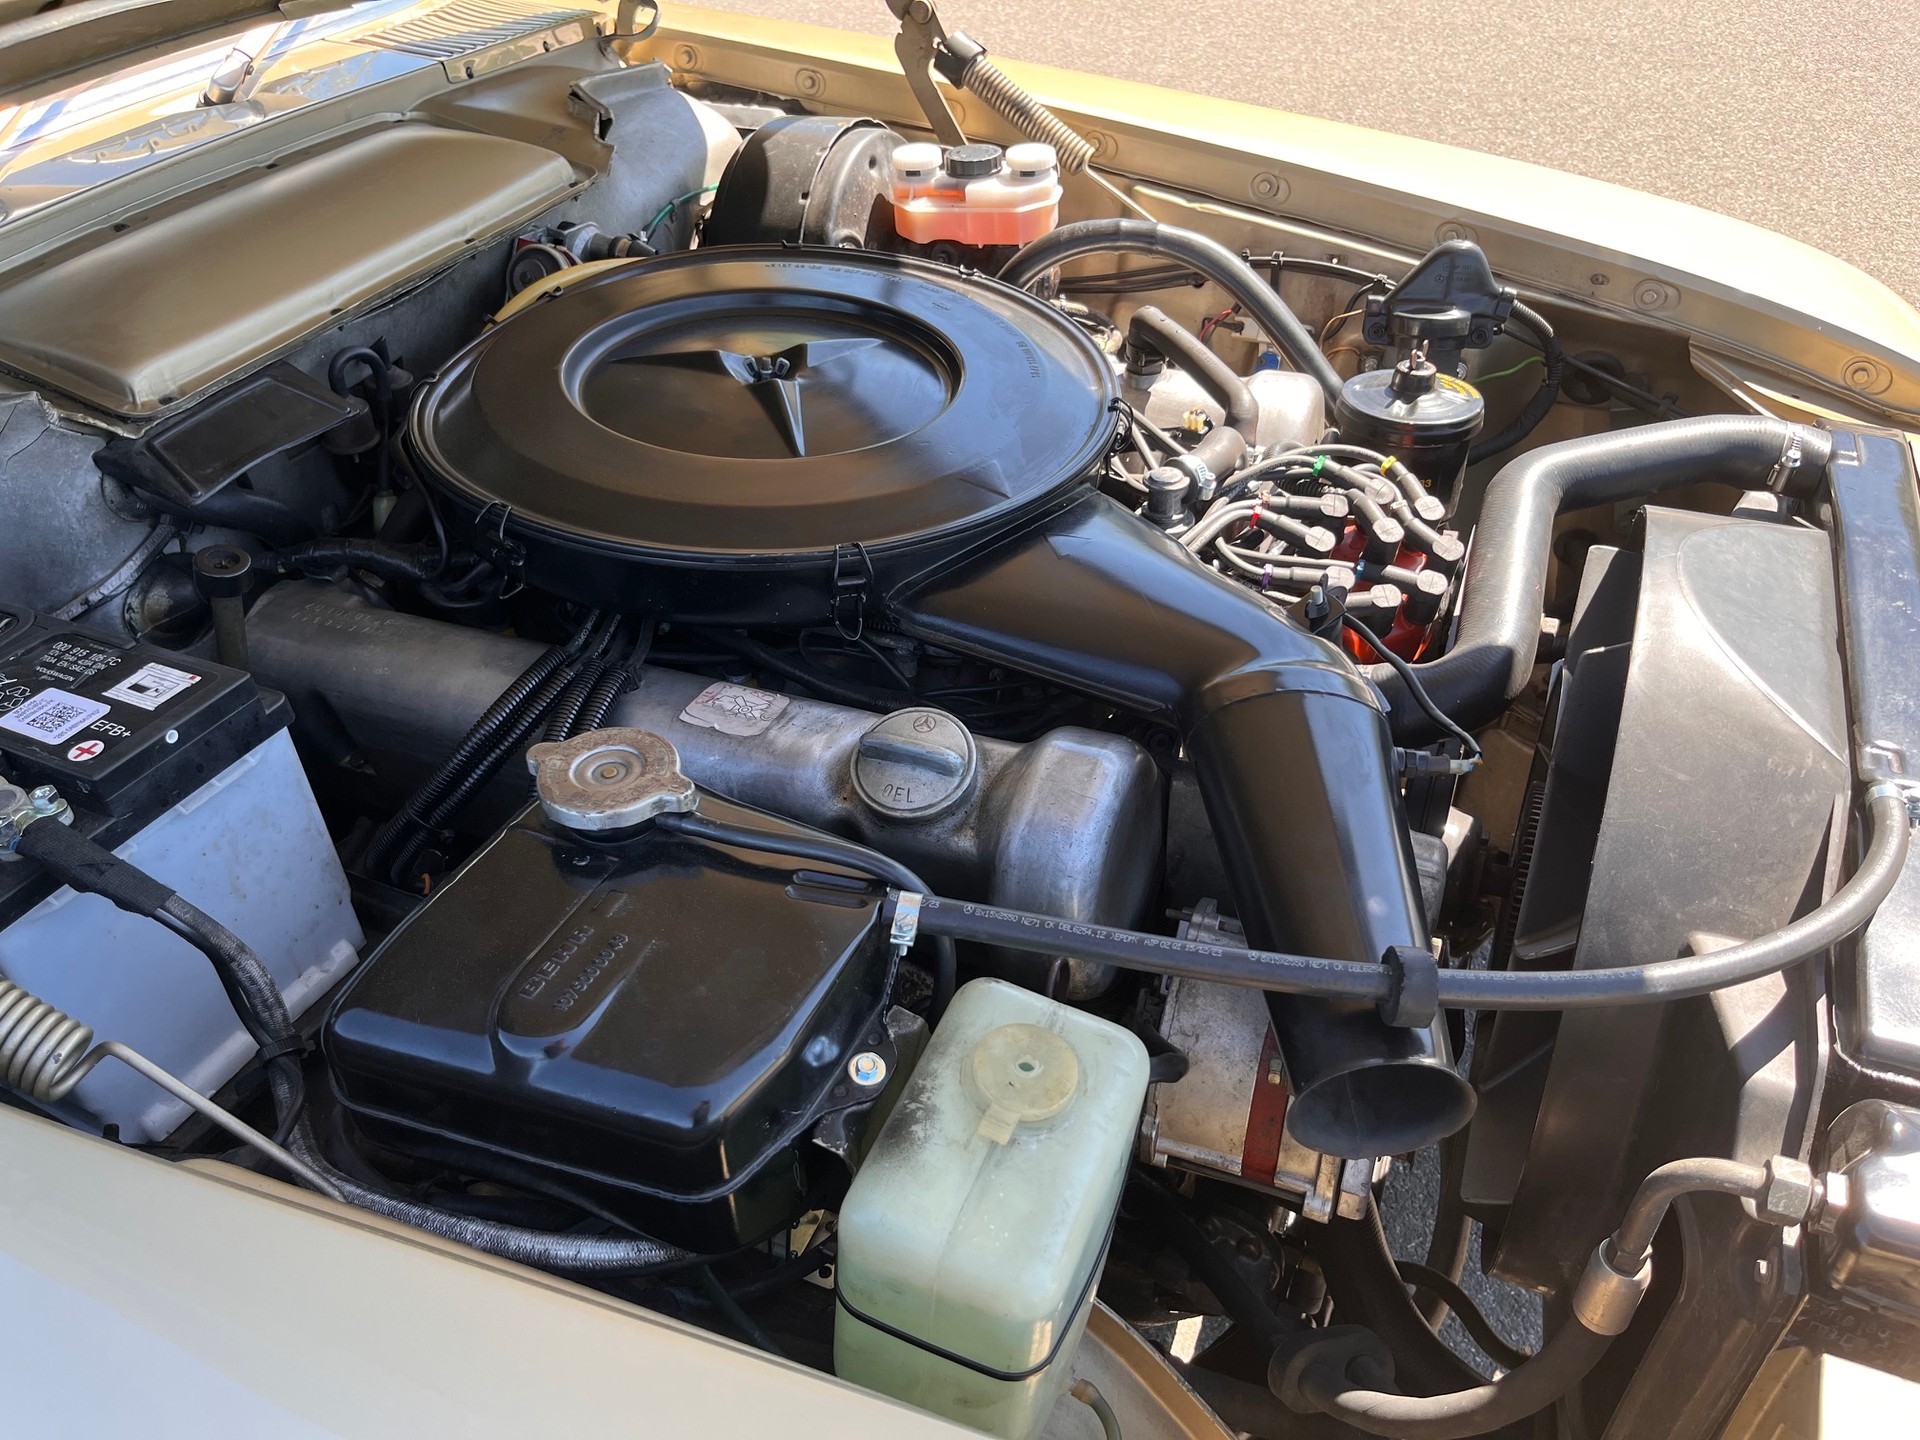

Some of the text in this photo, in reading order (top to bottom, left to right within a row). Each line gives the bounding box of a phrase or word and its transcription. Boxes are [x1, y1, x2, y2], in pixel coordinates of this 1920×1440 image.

[103, 656, 121, 666] FC
[36, 665, 76, 682] VOLKSWAGEN
[90, 720, 132, 738] EFB+
[881, 783, 916, 804] OEL
